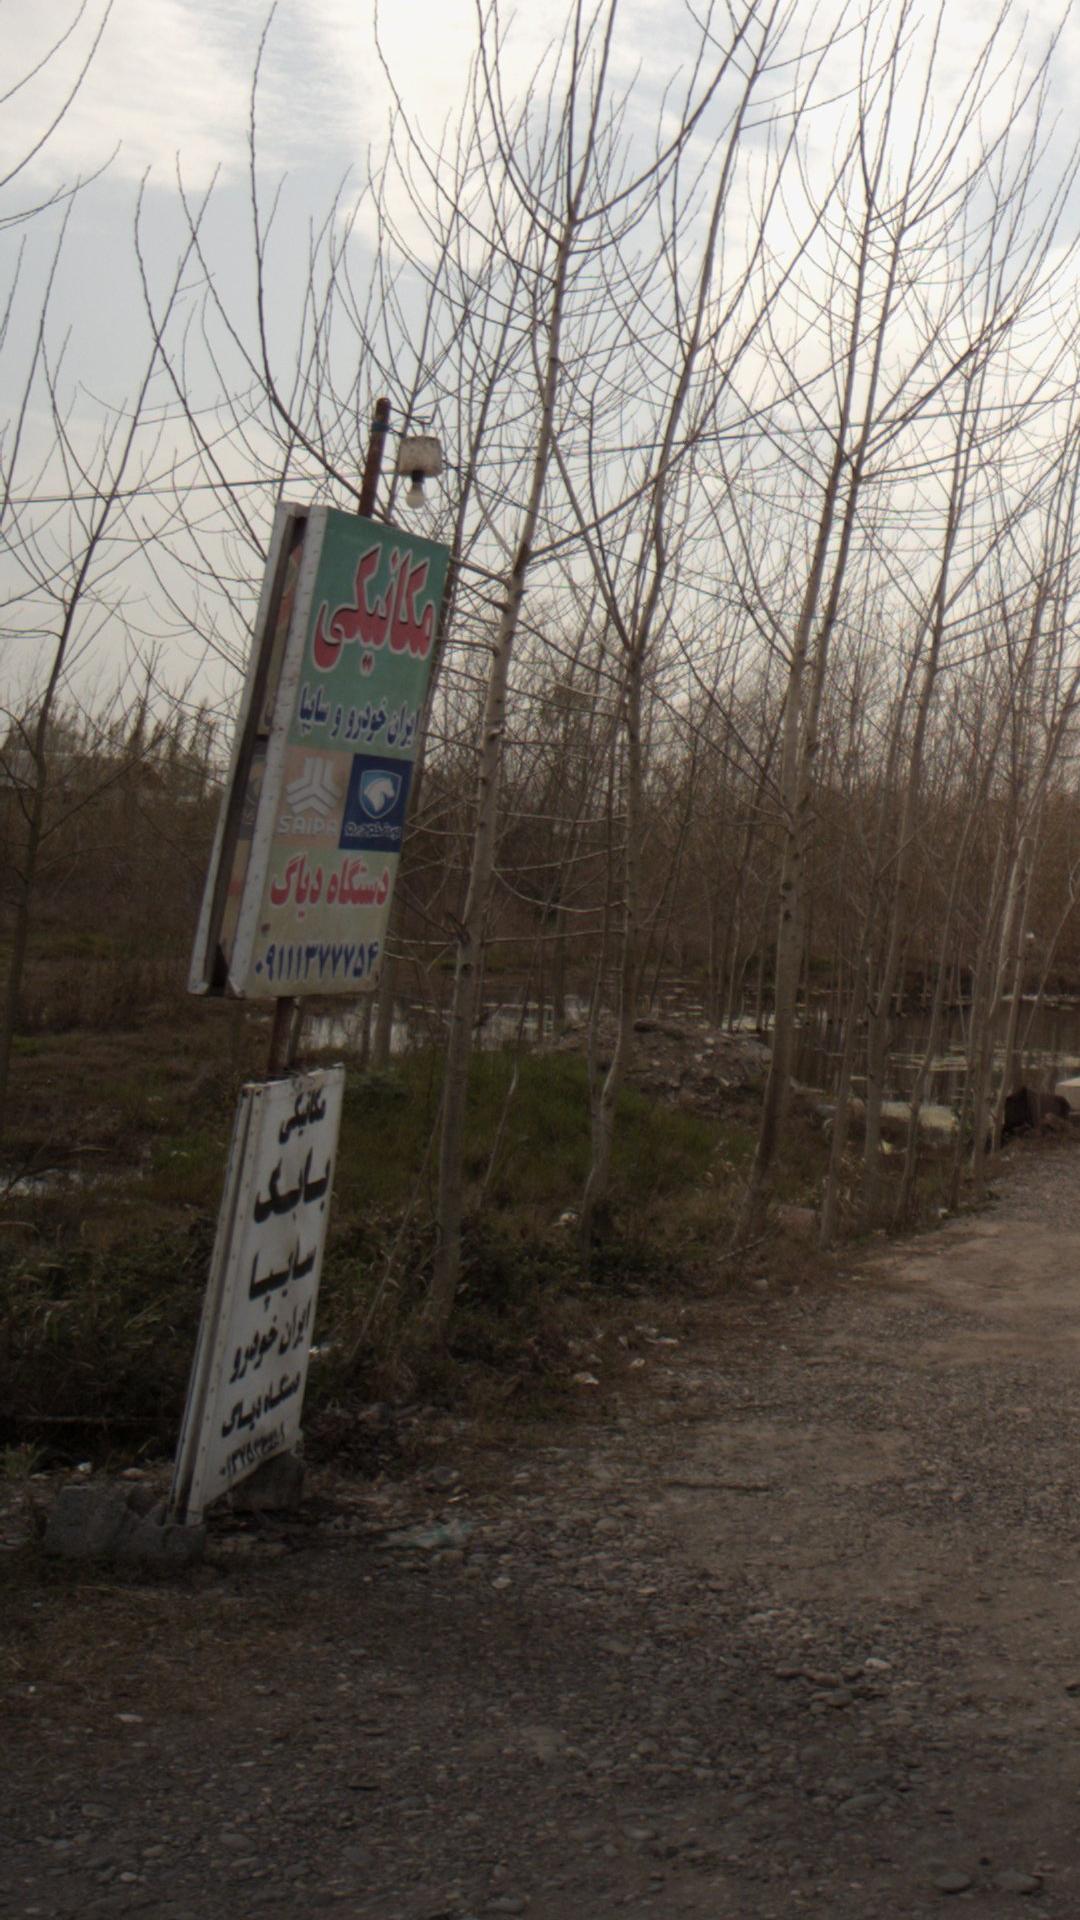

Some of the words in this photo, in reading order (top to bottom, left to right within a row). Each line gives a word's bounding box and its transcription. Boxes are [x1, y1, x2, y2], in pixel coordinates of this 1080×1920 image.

[313, 543, 435, 677] مکانیکی
[299, 685, 329, 736] سایپا
[331, 706, 342, 737] و
[345, 697, 388, 741] خودرو
[387, 700, 421, 747] ایران
[326, 858, 391, 907] دستگاه
[248, 1237, 317, 1312] سایپا
[229, 1315, 279, 1384] خودرو
[278, 1295, 312, 1355] ایران
